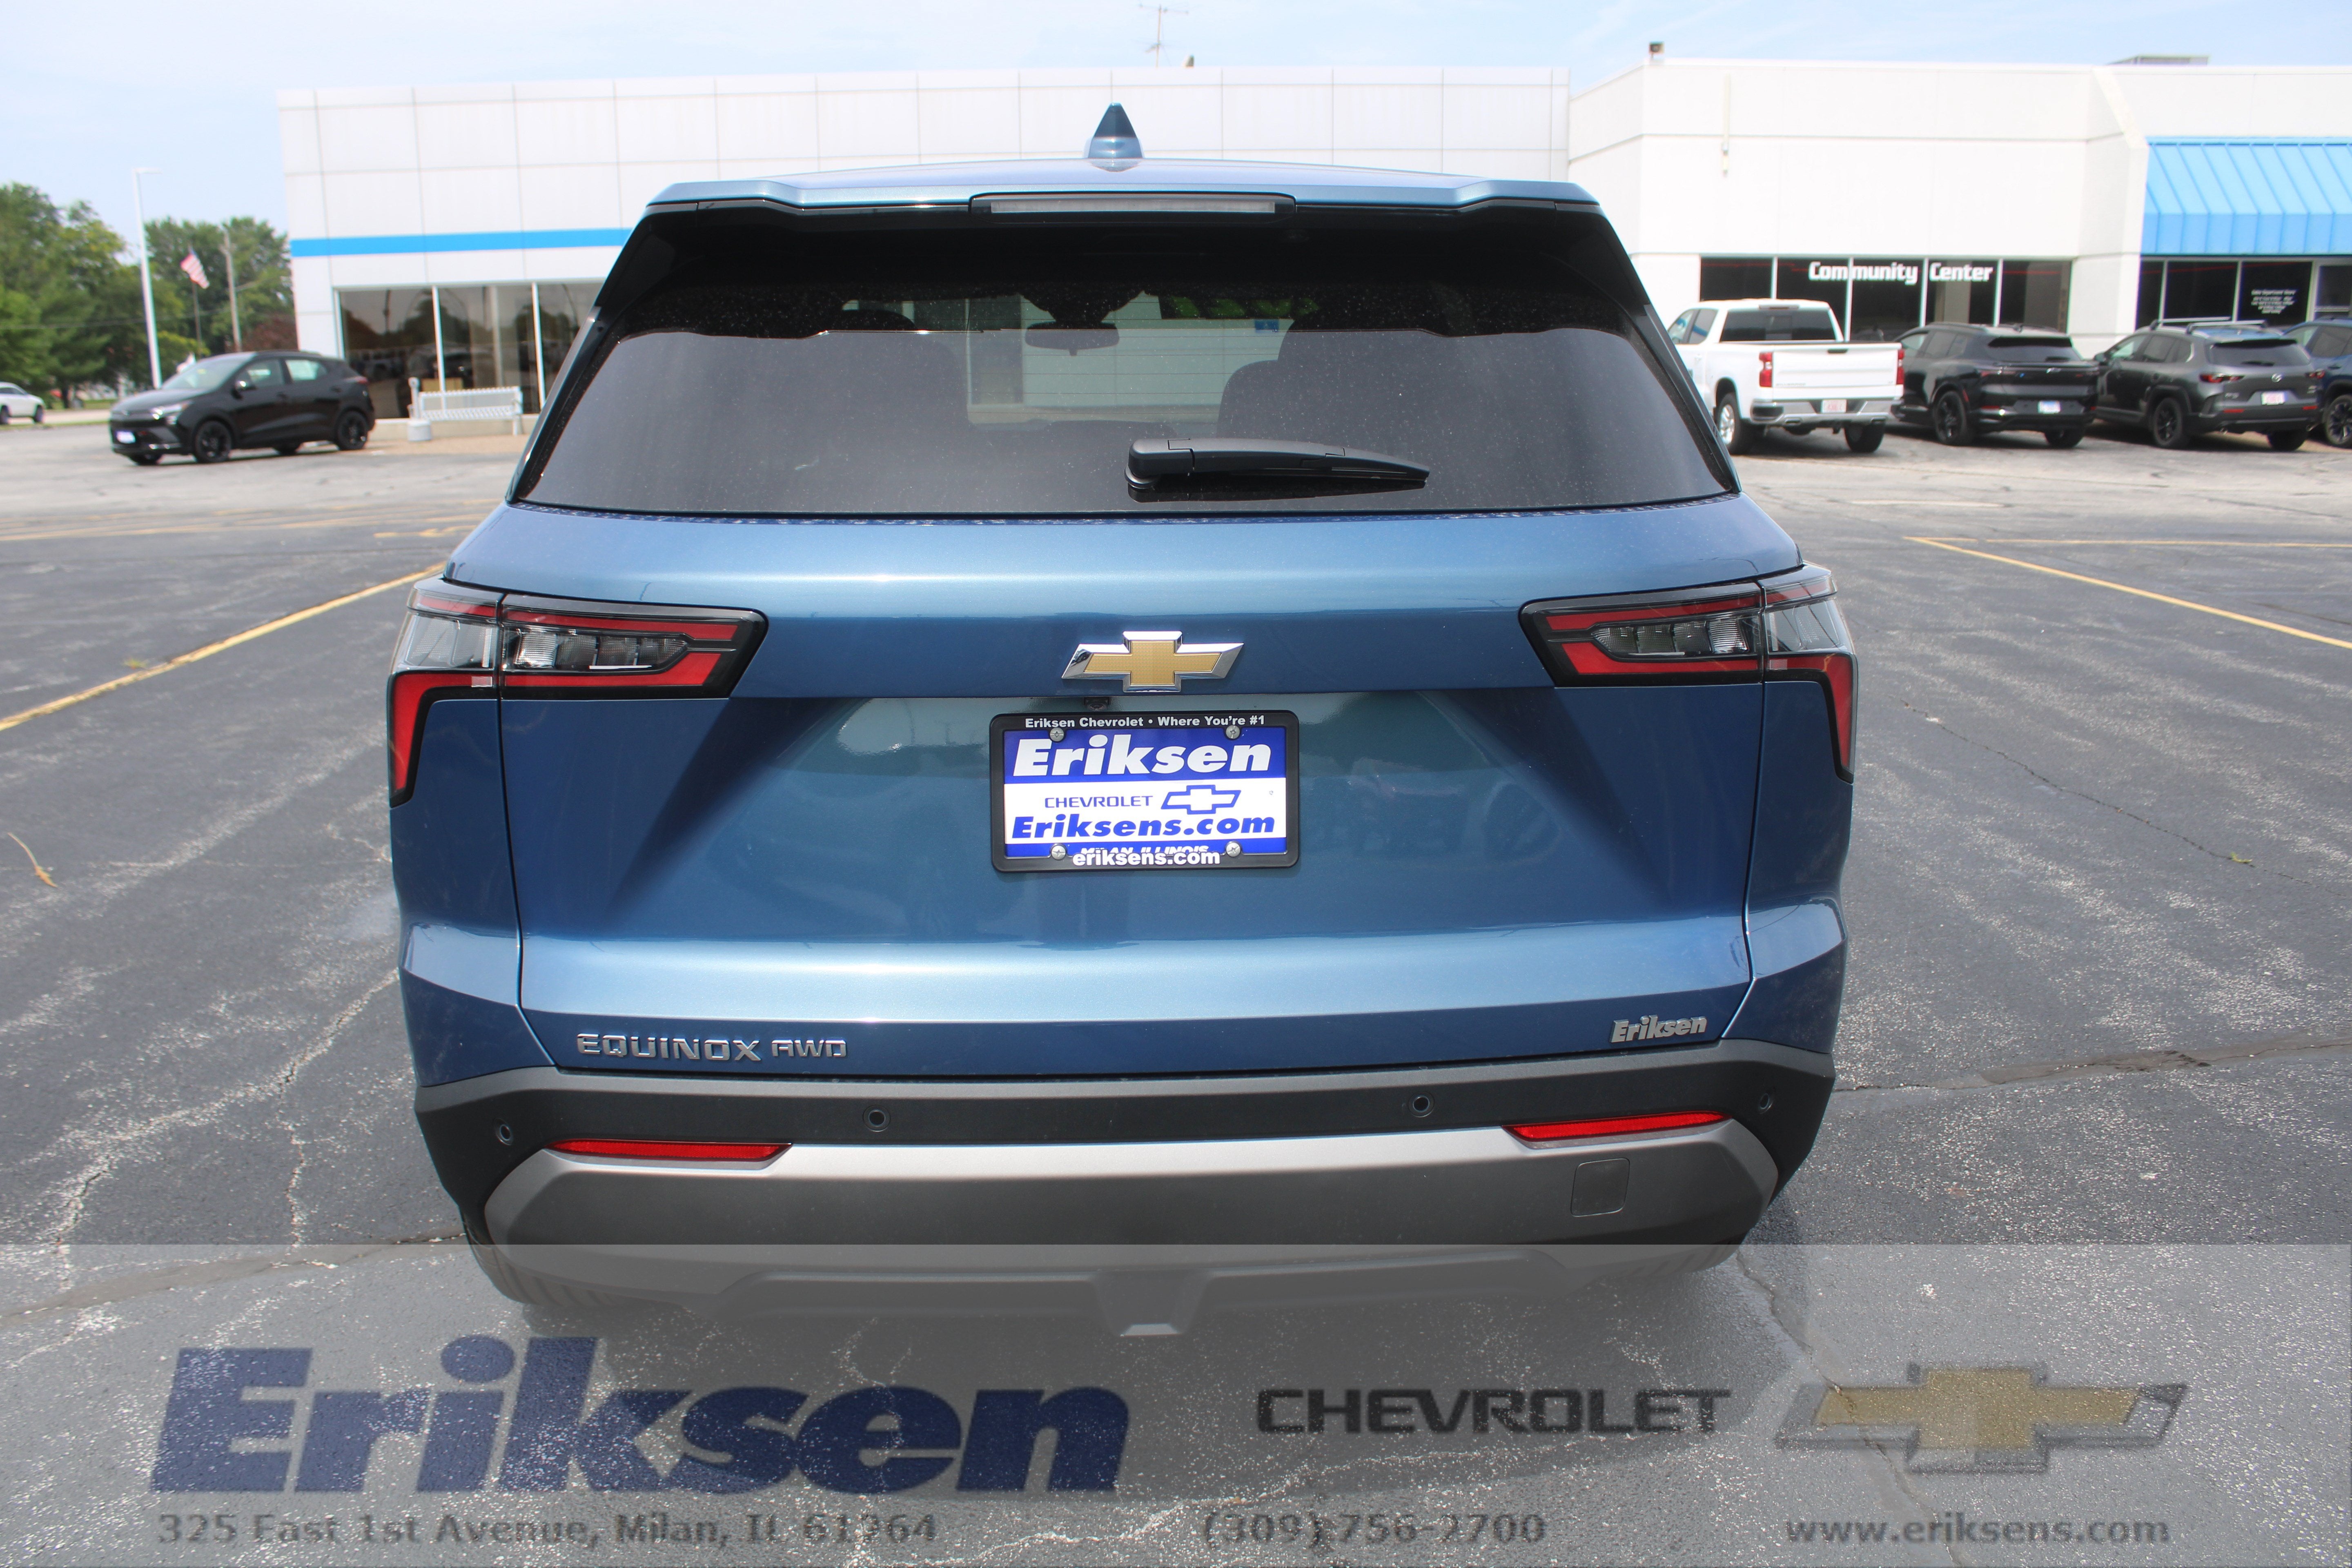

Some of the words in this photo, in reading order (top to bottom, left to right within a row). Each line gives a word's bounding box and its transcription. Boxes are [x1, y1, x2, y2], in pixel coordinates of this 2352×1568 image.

[1808, 261, 1918, 285] Community
[1929, 262, 1994, 282] Center
[1025, 717, 1075, 728] Eriksen
[1079, 717, 1144, 727] Chevrolet
[1157, 716, 1200, 726] Where
[1249, 715, 1265, 725] #1
[1013, 734, 1272, 777] Eriksen
[1045, 795, 1154, 808] CHEVROLET
[1012, 814, 1275, 839] Eriksens.com
[1072, 849, 1221, 866] eriksens.com
[1610, 1014, 1707, 1043] Eriksen
[577, 1033, 762, 1061] EQUINOX
[771, 1039, 847, 1058] AWD
